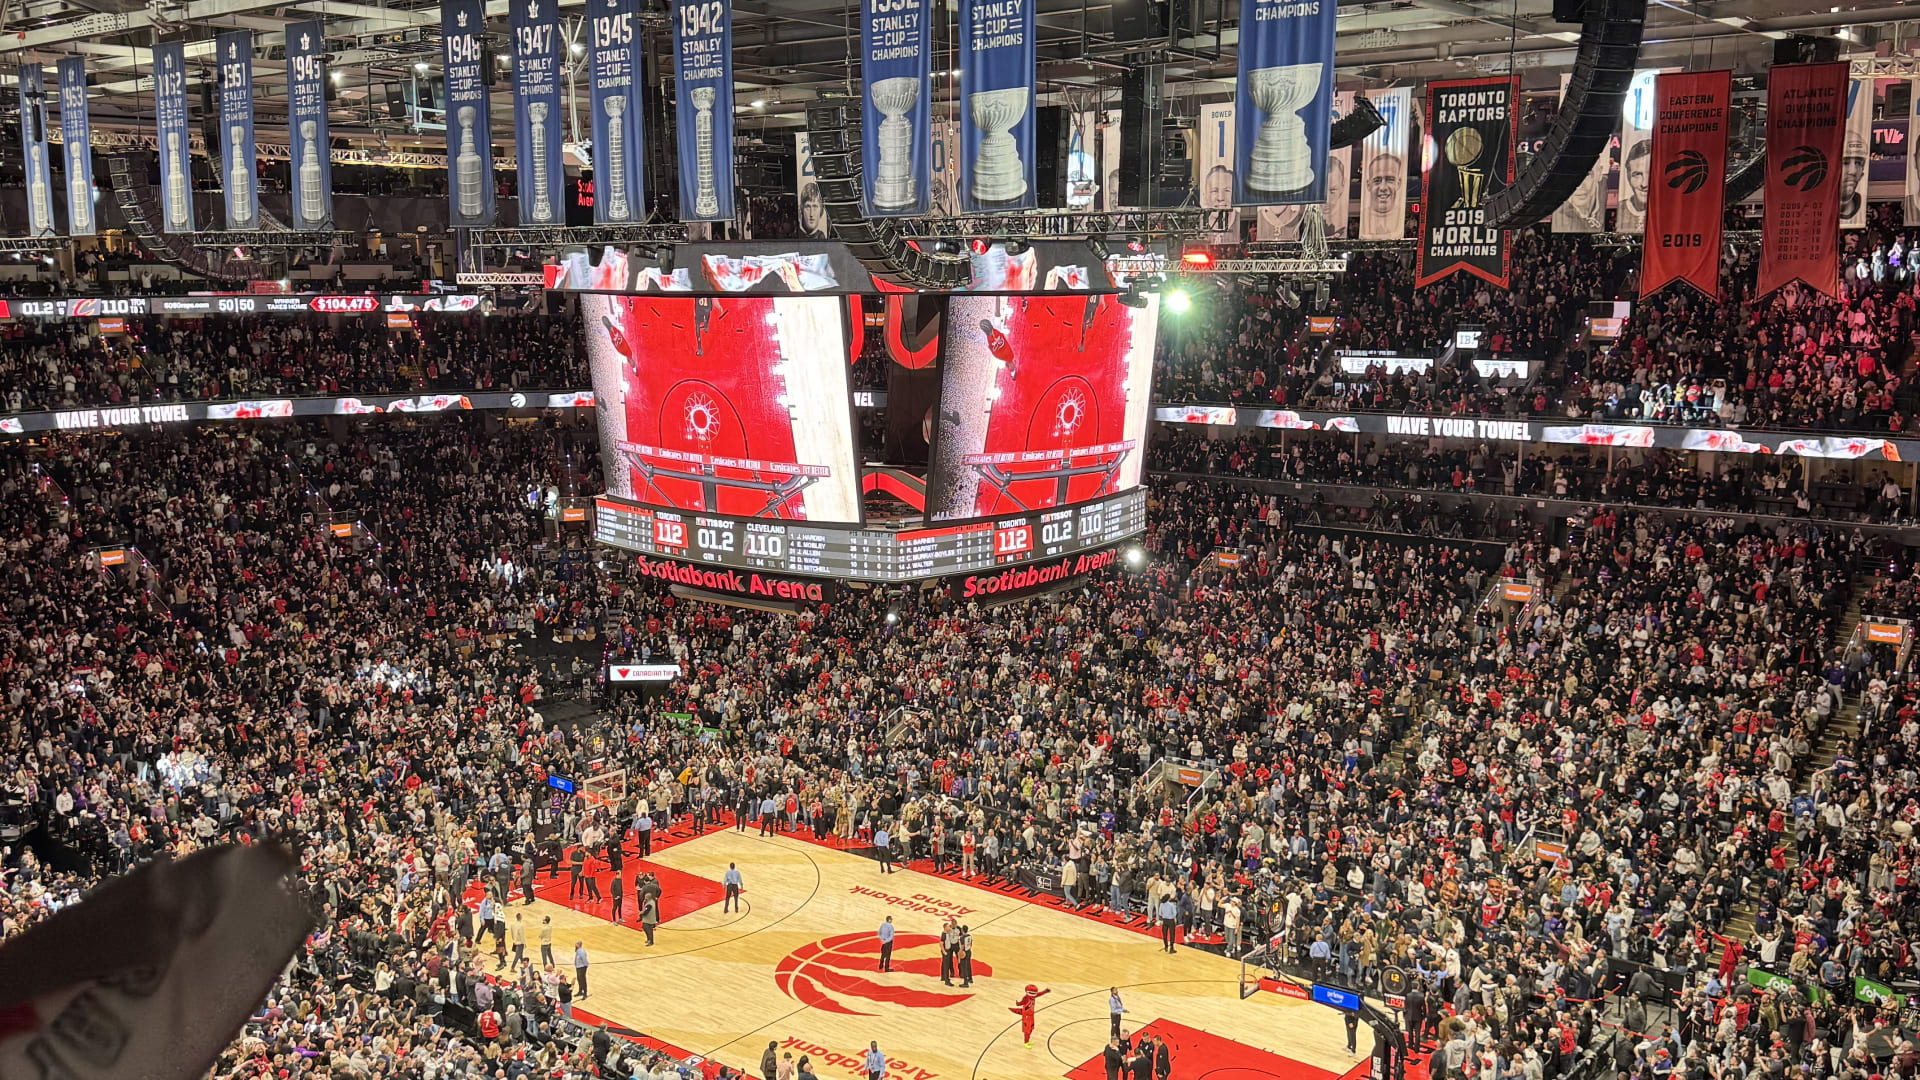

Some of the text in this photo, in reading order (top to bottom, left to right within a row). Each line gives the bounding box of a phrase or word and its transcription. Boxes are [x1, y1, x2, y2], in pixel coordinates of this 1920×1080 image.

[972, 0, 1022, 20] STANLEY
[1256, 2, 1320, 21] CHAMPIONS
[680, 1, 724, 37] 1942
[872, 14, 918, 32] STANLEY
[986, 18, 1008, 35] CUP
[593, 12, 632, 48] 1945
[516, 24, 552, 56] 1947
[682, 38, 722, 54] STANLEY
[884, 31, 906, 46] CUP
[972, 33, 1022, 50] CHAMPIONS
[596, 48, 630, 63] STANLEY
[872, 45, 918, 61] CHAMPIONS
[694, 55, 712, 67] CUP
[450, 65, 480, 78] STANLEY
[606, 63, 622, 76] CUP
[684, 67, 723, 80] CHAMPIONS
[458, 79, 472, 90] CUP
[528, 72, 544, 84] CUP
[1440, 90, 1505, 107] TORONTO
[1670, 94, 1714, 106] EASTERN
[1784, 87, 1835, 99] ATLANTIC
[1438, 106, 1505, 123] RAPTORS
[1660, 108, 1722, 120] CONFERENCE
[1786, 103, 1830, 114] DIVISION
[1661, 122, 1718, 134] CHAMPIONS
[1776, 116, 1836, 129] CHAMPIONS
[1218, 121, 1224, 158] 1
[1445, 210, 1484, 226] 2019
[1432, 228, 1498, 244] WORLD
[1662, 233, 1702, 248] 2019
[1431, 245, 1497, 257] CHAMPIONS
[22, 302, 54, 315] 01.2
[102, 300, 128, 314] 110
[318, 296, 372, 310] $104,475
[56, 404, 189, 430] WAVE YOUR TOWEL
[1386, 416, 1532, 440] WAVE YOUR TOWEL
[710, 456, 736, 468] Emirates
[770, 462, 800, 474] Emirates
[1051, 510, 1072, 521] TISSOT
[706, 519, 734, 529] TISSOT
[746, 523, 786, 534] CLEVELAND
[998, 518, 1026, 529] TORONTO
[1080, 513, 1101, 536] 110
[657, 522, 682, 544] 112
[1042, 520, 1072, 544] 01.2
[698, 528, 734, 552] 01.2
[748, 534, 782, 556] 110
[998, 529, 1026, 552] 112
[913, 544, 938, 553] BARRETT
[912, 560, 934, 568] WALTER
[638, 556, 822, 601] Scotiabank Arena
[963, 549, 1116, 598] Scotiabank Arena
[848, 886, 962, 922] Scotiabank
[911, 894, 977, 915] Arena
[1391, 973, 1399, 982] 12
[1327, 991, 1344, 1000] prime
[780, 1036, 903, 1080] tiabank
[856, 1048, 939, 1080] Area
